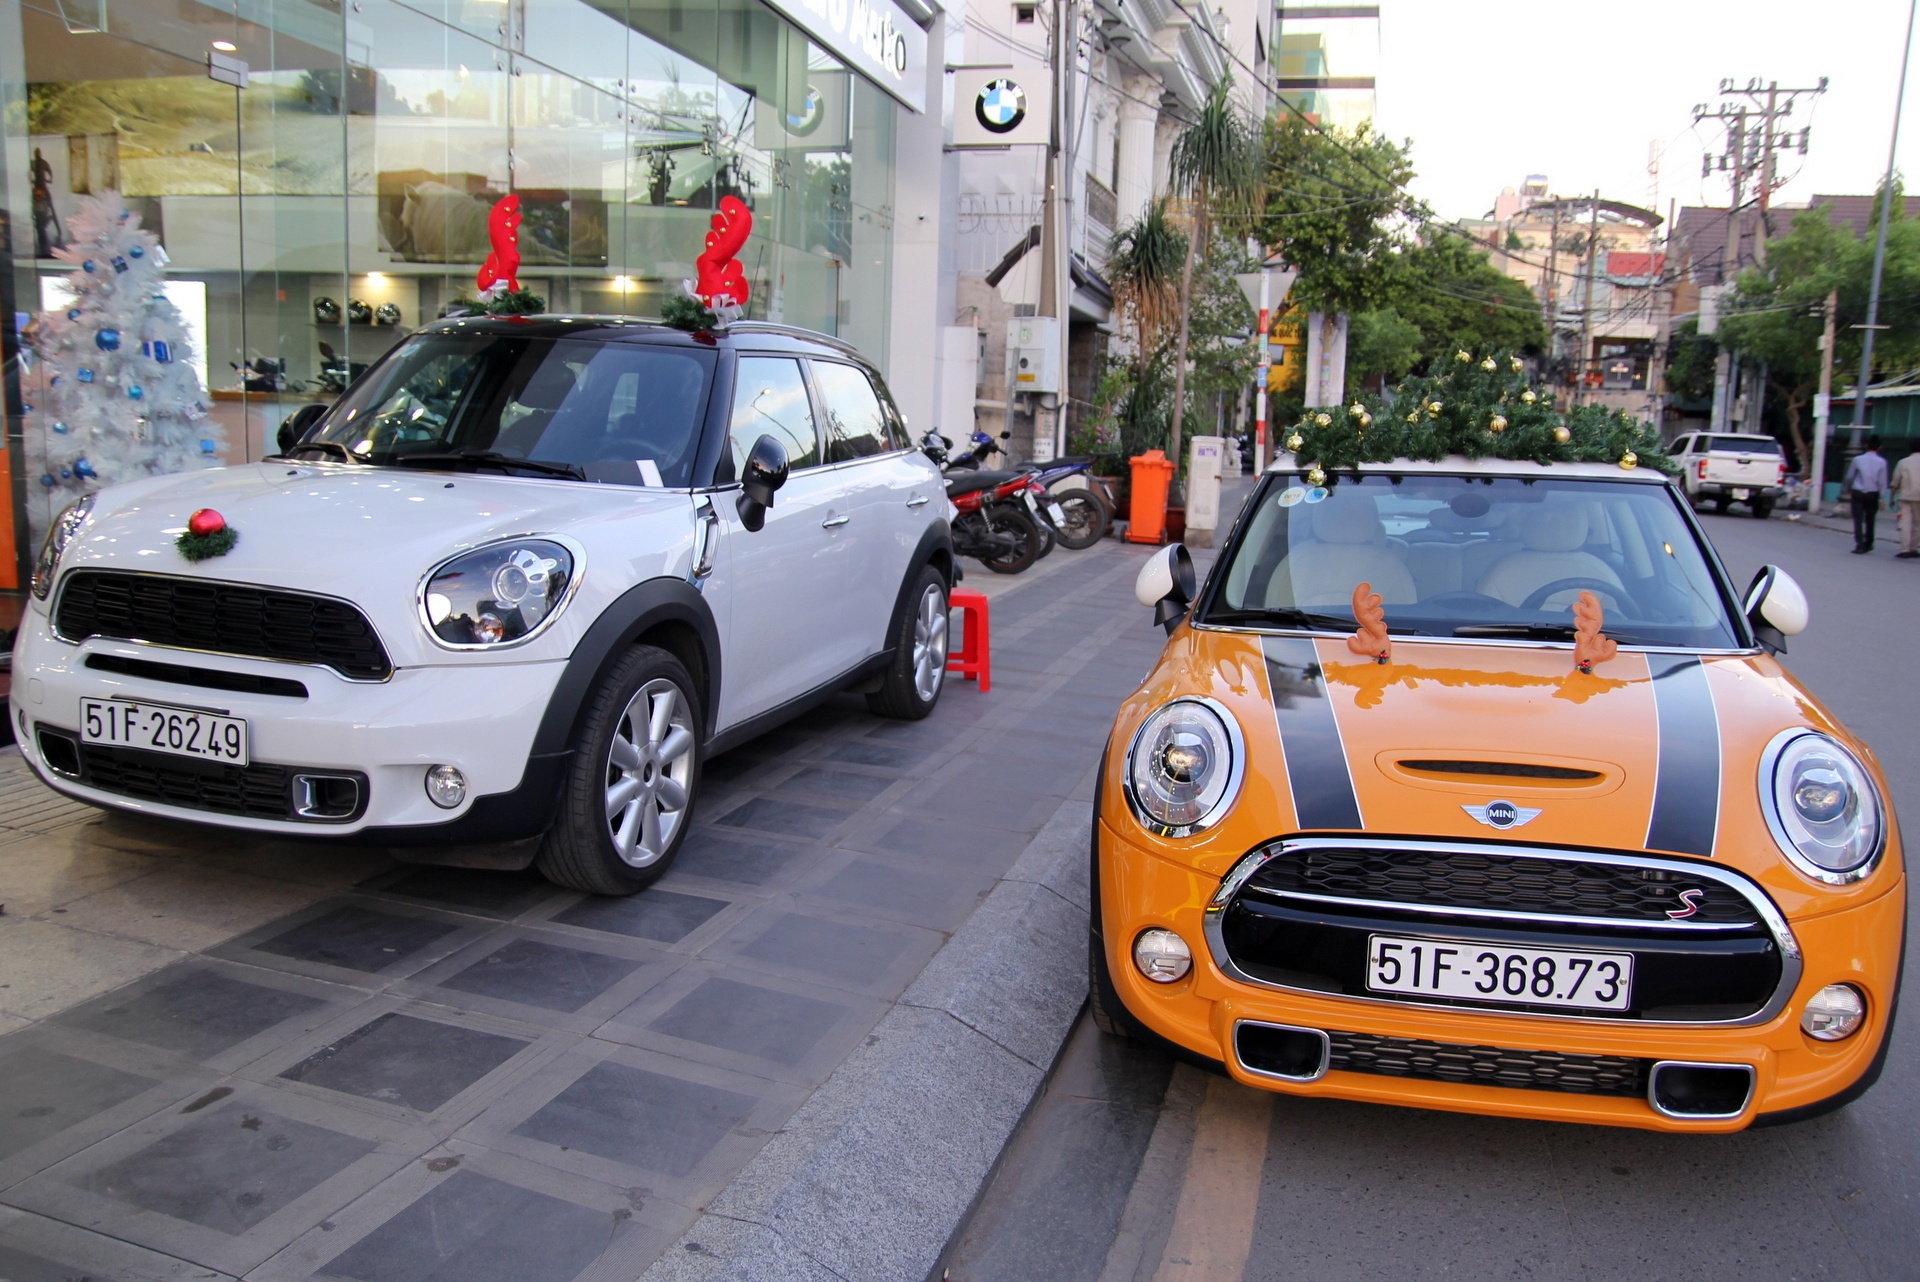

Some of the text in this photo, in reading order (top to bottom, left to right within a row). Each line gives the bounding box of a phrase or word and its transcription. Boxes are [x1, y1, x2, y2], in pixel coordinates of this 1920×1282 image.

[980, 79, 1024, 99] BMW
[87, 703, 240, 759] 51F-262.49
[1489, 804, 1514, 819] MINI
[1378, 943, 1621, 1002] 51F-368.73
